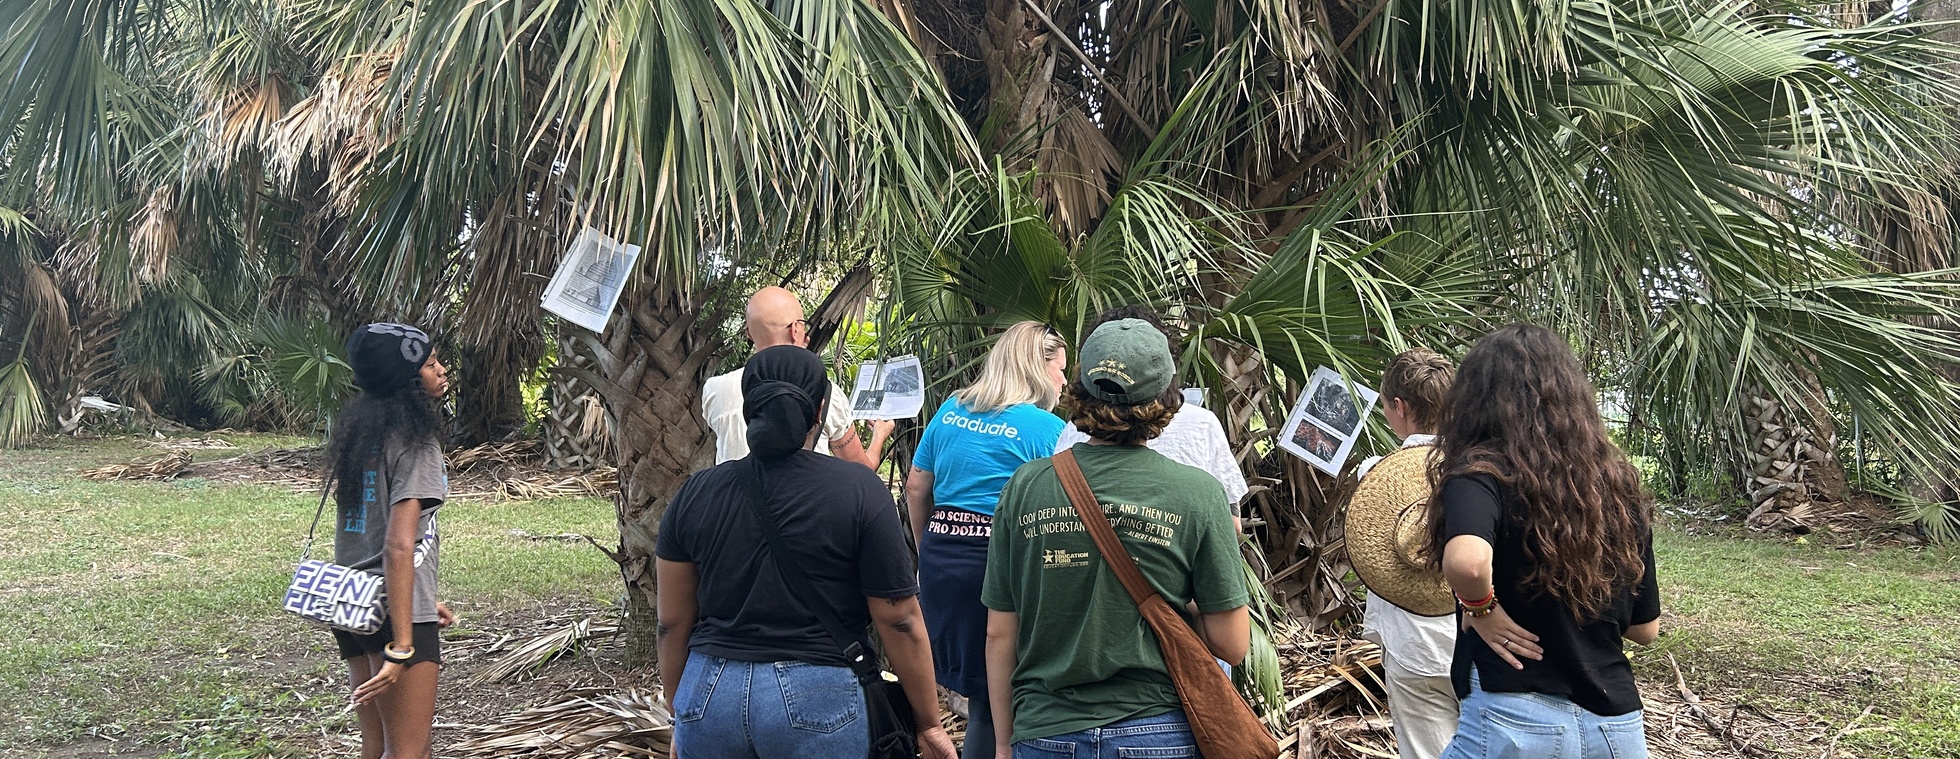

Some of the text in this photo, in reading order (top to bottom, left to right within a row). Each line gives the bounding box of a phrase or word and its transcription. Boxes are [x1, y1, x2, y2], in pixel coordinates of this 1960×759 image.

[942, 411, 1021, 441] Graduate.
[1038, 507, 1056, 521] DEEP
[1059, 506, 1078, 517] INTO
[1119, 503, 1138, 515] AND
[1141, 506, 1162, 520] THEN
[1164, 511, 1182, 525] YOU
[928, 521, 992, 537] PRO DOLLY
[1039, 521, 1087, 535] UNDERSTAN
[1145, 522, 1174, 539] BETTER
[1148, 535, 1171, 547] EINSTEIN
